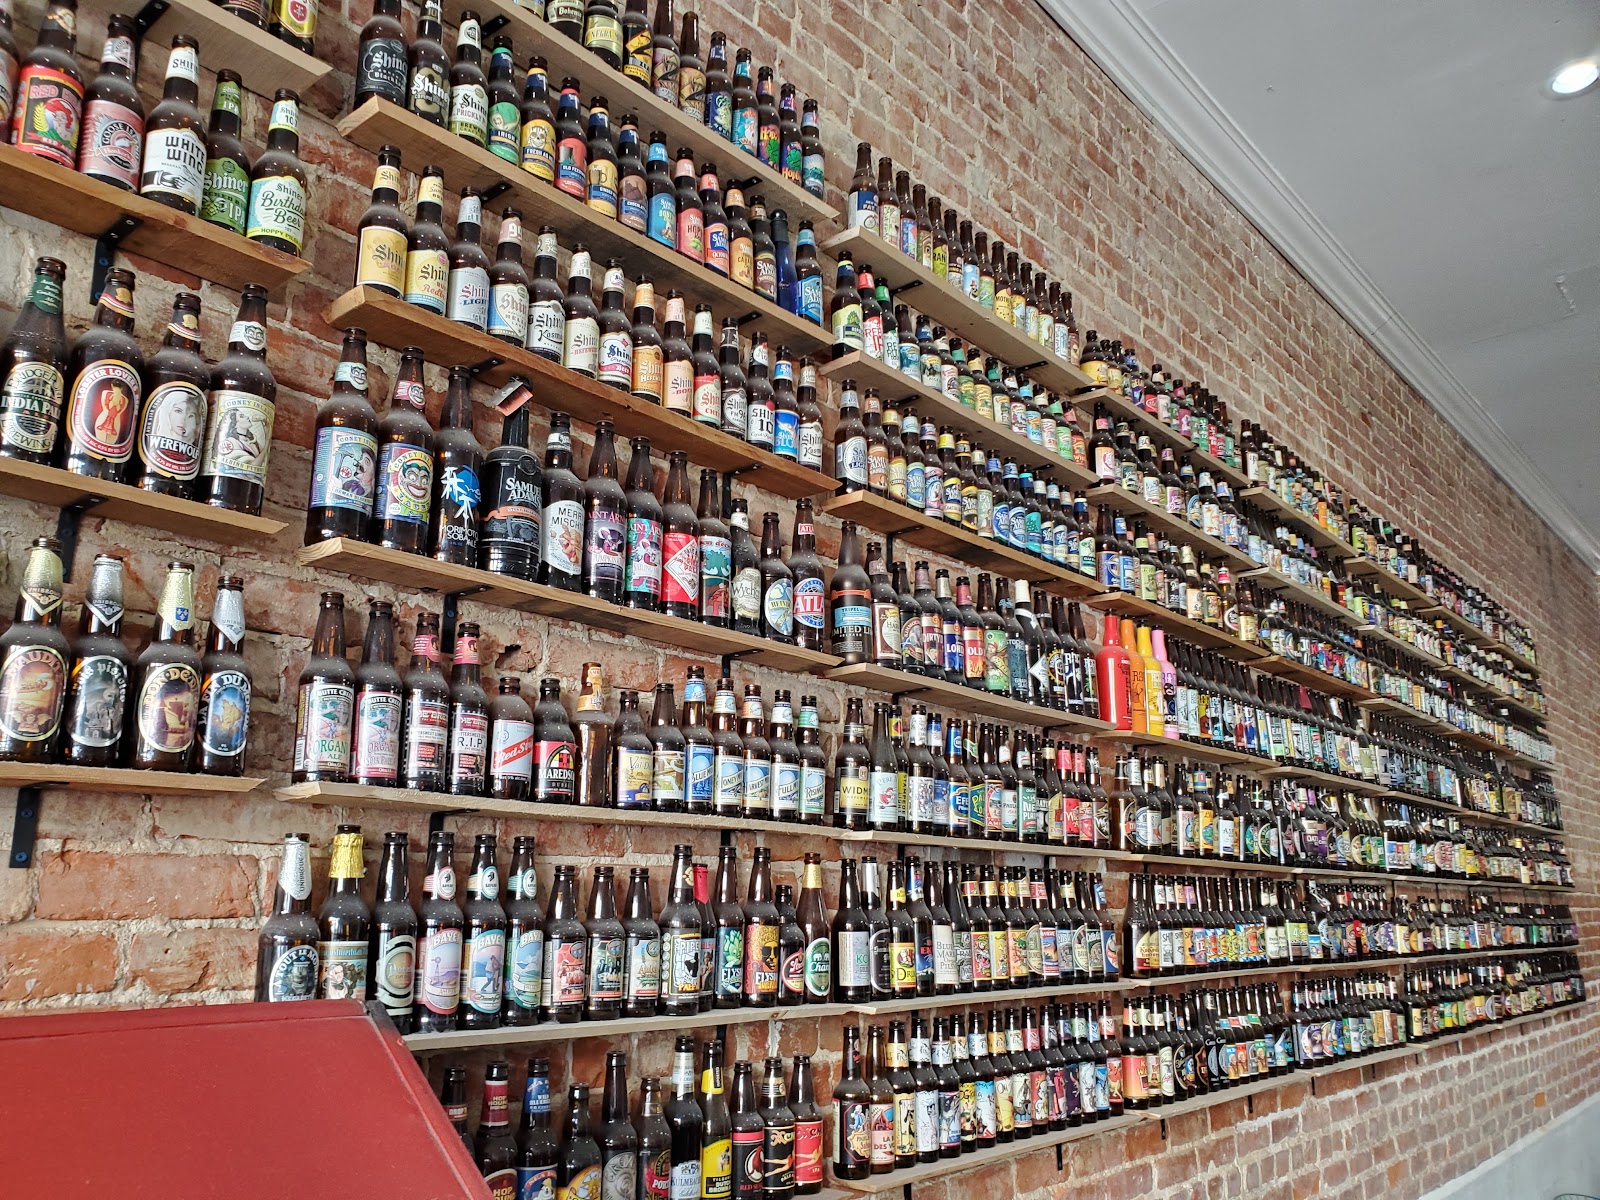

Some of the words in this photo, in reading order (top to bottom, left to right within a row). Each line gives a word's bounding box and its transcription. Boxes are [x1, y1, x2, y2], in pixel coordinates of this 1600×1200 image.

[558, 7, 582, 18] Bohemia
[29, 84, 59, 99] RED
[102, 124, 124, 144] GOOSE
[165, 136, 206, 162] WHITE
[167, 149, 204, 175] WING
[228, 205, 246, 226] IPA
[77, 369, 107, 401] LOBSTER
[150, 435, 199, 460] WEREWOLF
[507, 491, 541, 505] ADAMS
[446, 532, 467, 541] SOBA
[967, 646, 981, 655] OLD
[222, 674, 241, 686] DU
[278, 952, 297, 971] TOUT
[493, 1187, 513, 1196] HOP
